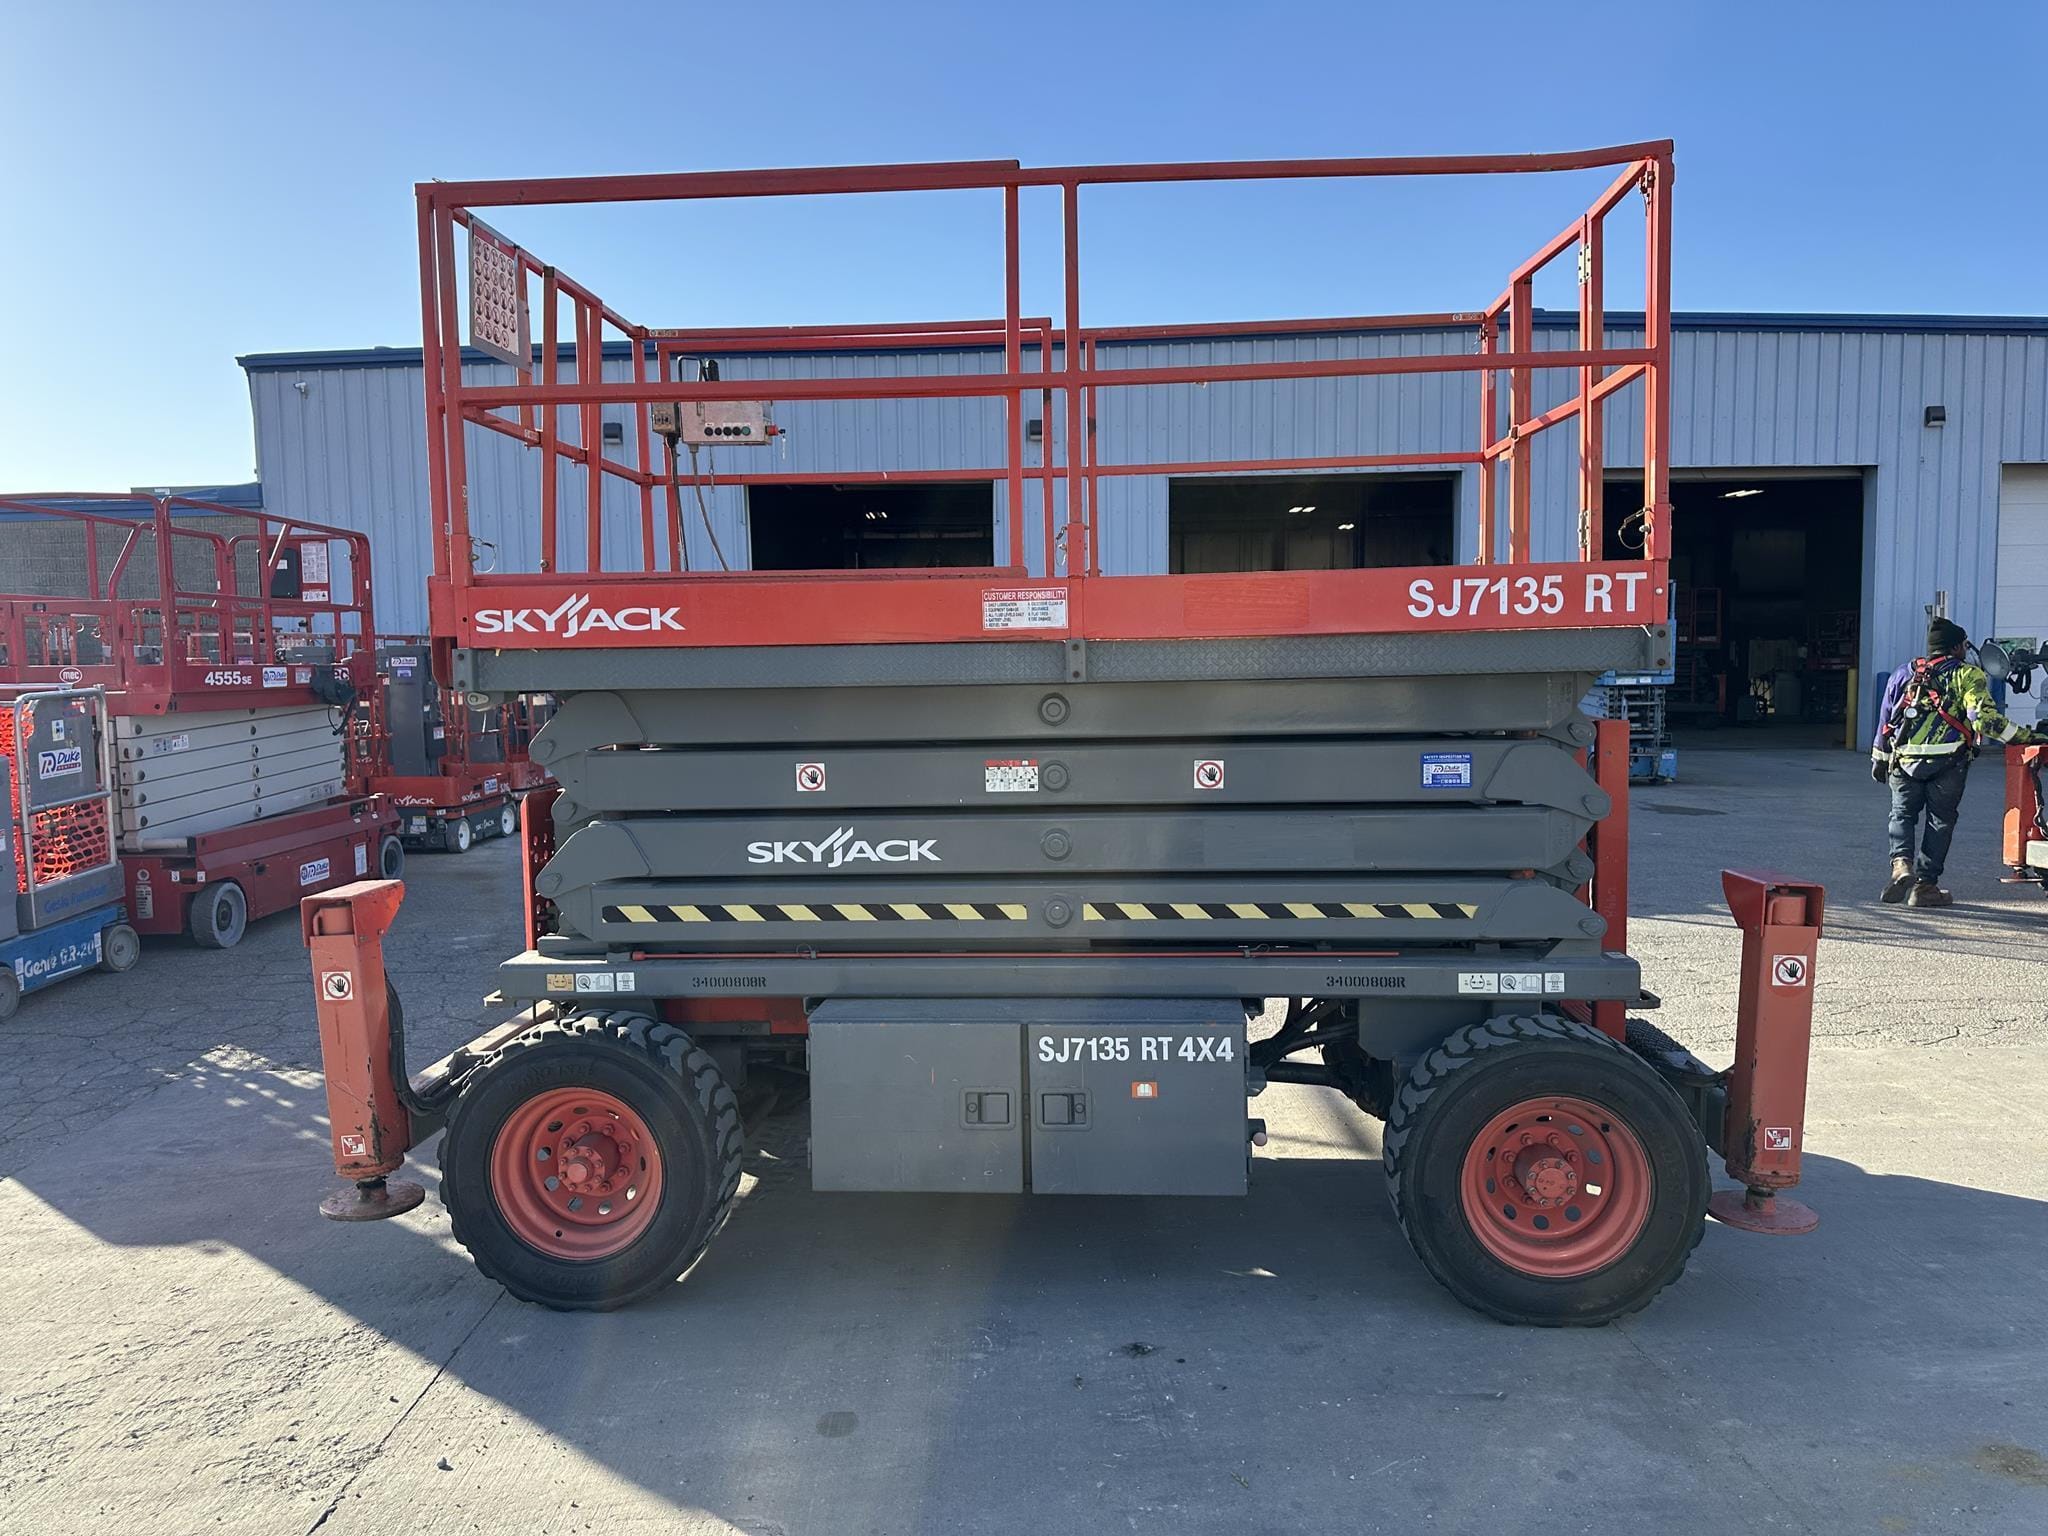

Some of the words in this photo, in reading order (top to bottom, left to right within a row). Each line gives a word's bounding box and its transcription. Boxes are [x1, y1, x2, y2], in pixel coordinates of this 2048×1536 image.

[474, 592, 686, 638] SKYJACK
[984, 592, 1016, 600] CUSTOMER
[1017, 590, 1065, 600] RESPONSIBILITY
[1407, 574, 1564, 618] SJ7135
[1584, 571, 1647, 613] RT
[747, 826, 942, 868] SKYJACK
[1038, 1036, 1130, 1062] SJ7135
[1141, 1036, 1173, 1061] RT
[1178, 1036, 1234, 1062] 4X4
